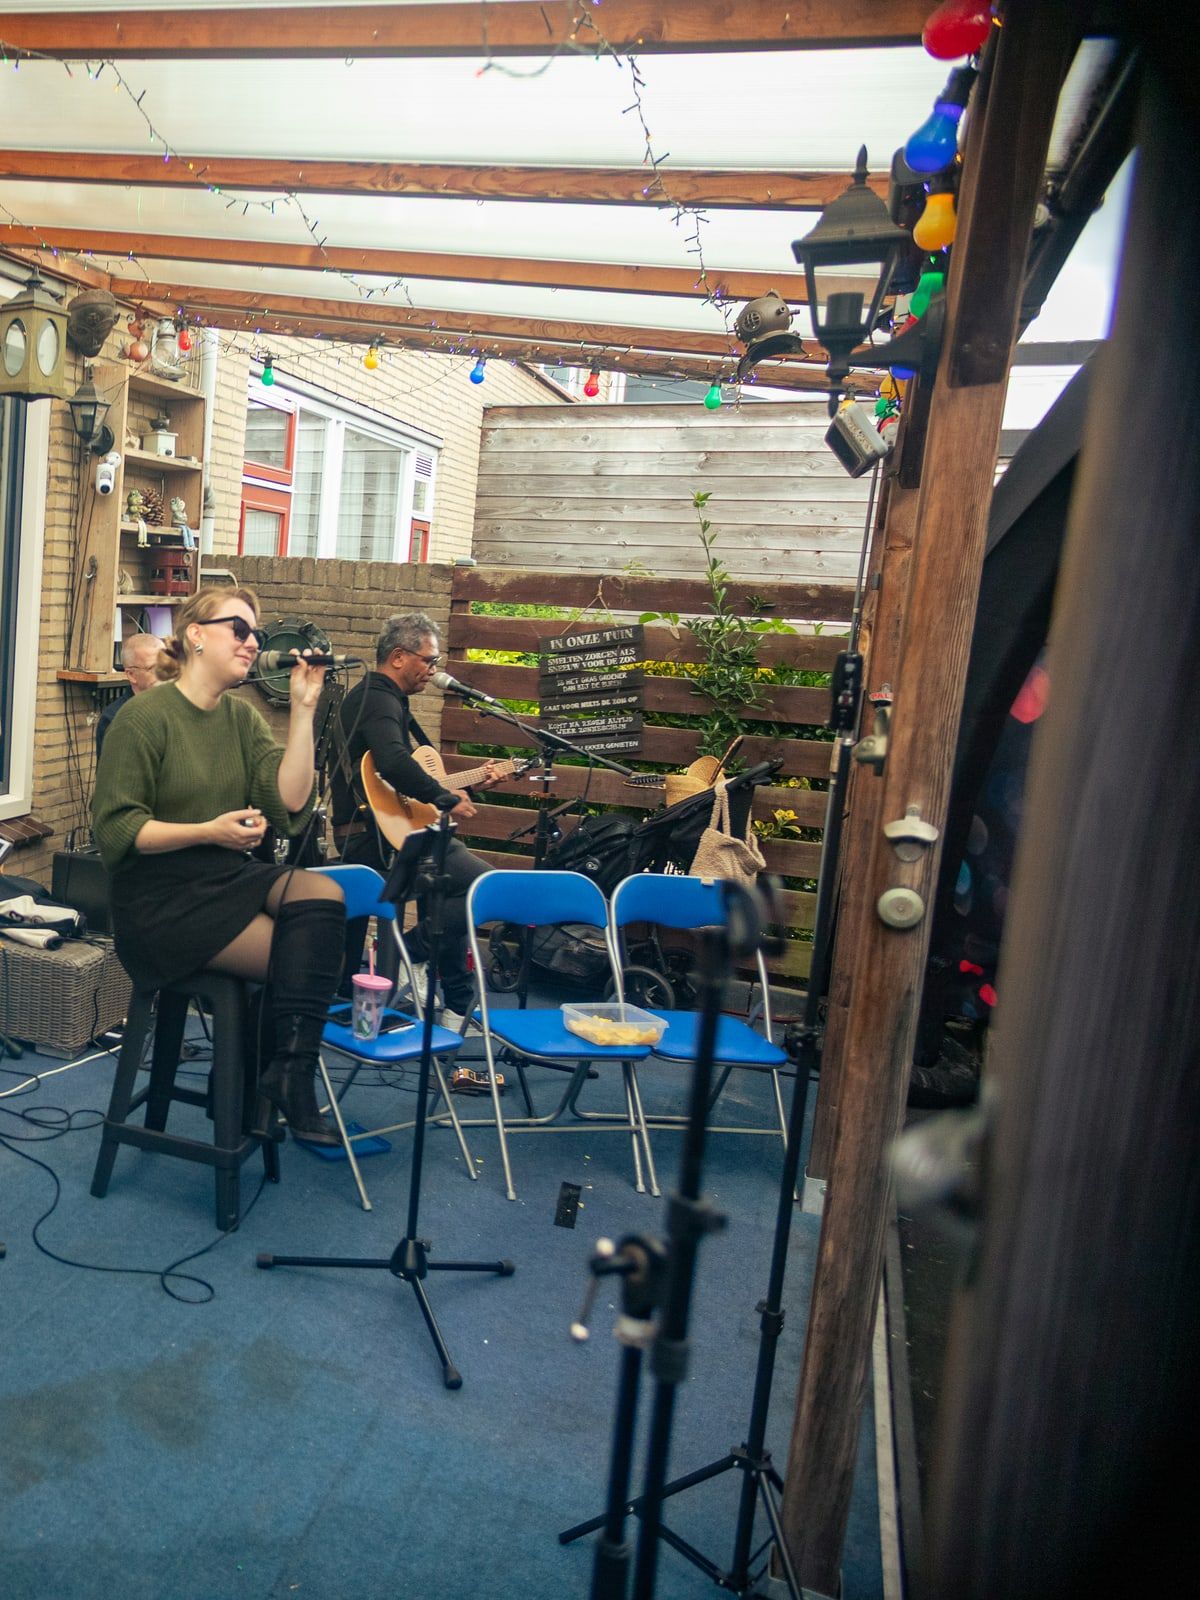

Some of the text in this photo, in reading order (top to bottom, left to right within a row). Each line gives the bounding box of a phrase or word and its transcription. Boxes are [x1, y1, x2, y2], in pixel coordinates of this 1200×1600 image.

[550, 628, 634, 650] IN ONZE TUIN
[547, 647, 635, 666] SMELTEN ZORGEN ALS
[548, 655, 637, 674] SNEEUW VOOR DE ZON
[565, 677, 579, 685] HET
[580, 675, 598, 683] GRAS
[598, 672, 628, 681] GROENER
[577, 683, 589, 691] BIJ
[543, 704, 560, 712] GAAT
[561, 702, 580, 710] VOOR
[607, 716, 634, 724] ALTIJD
